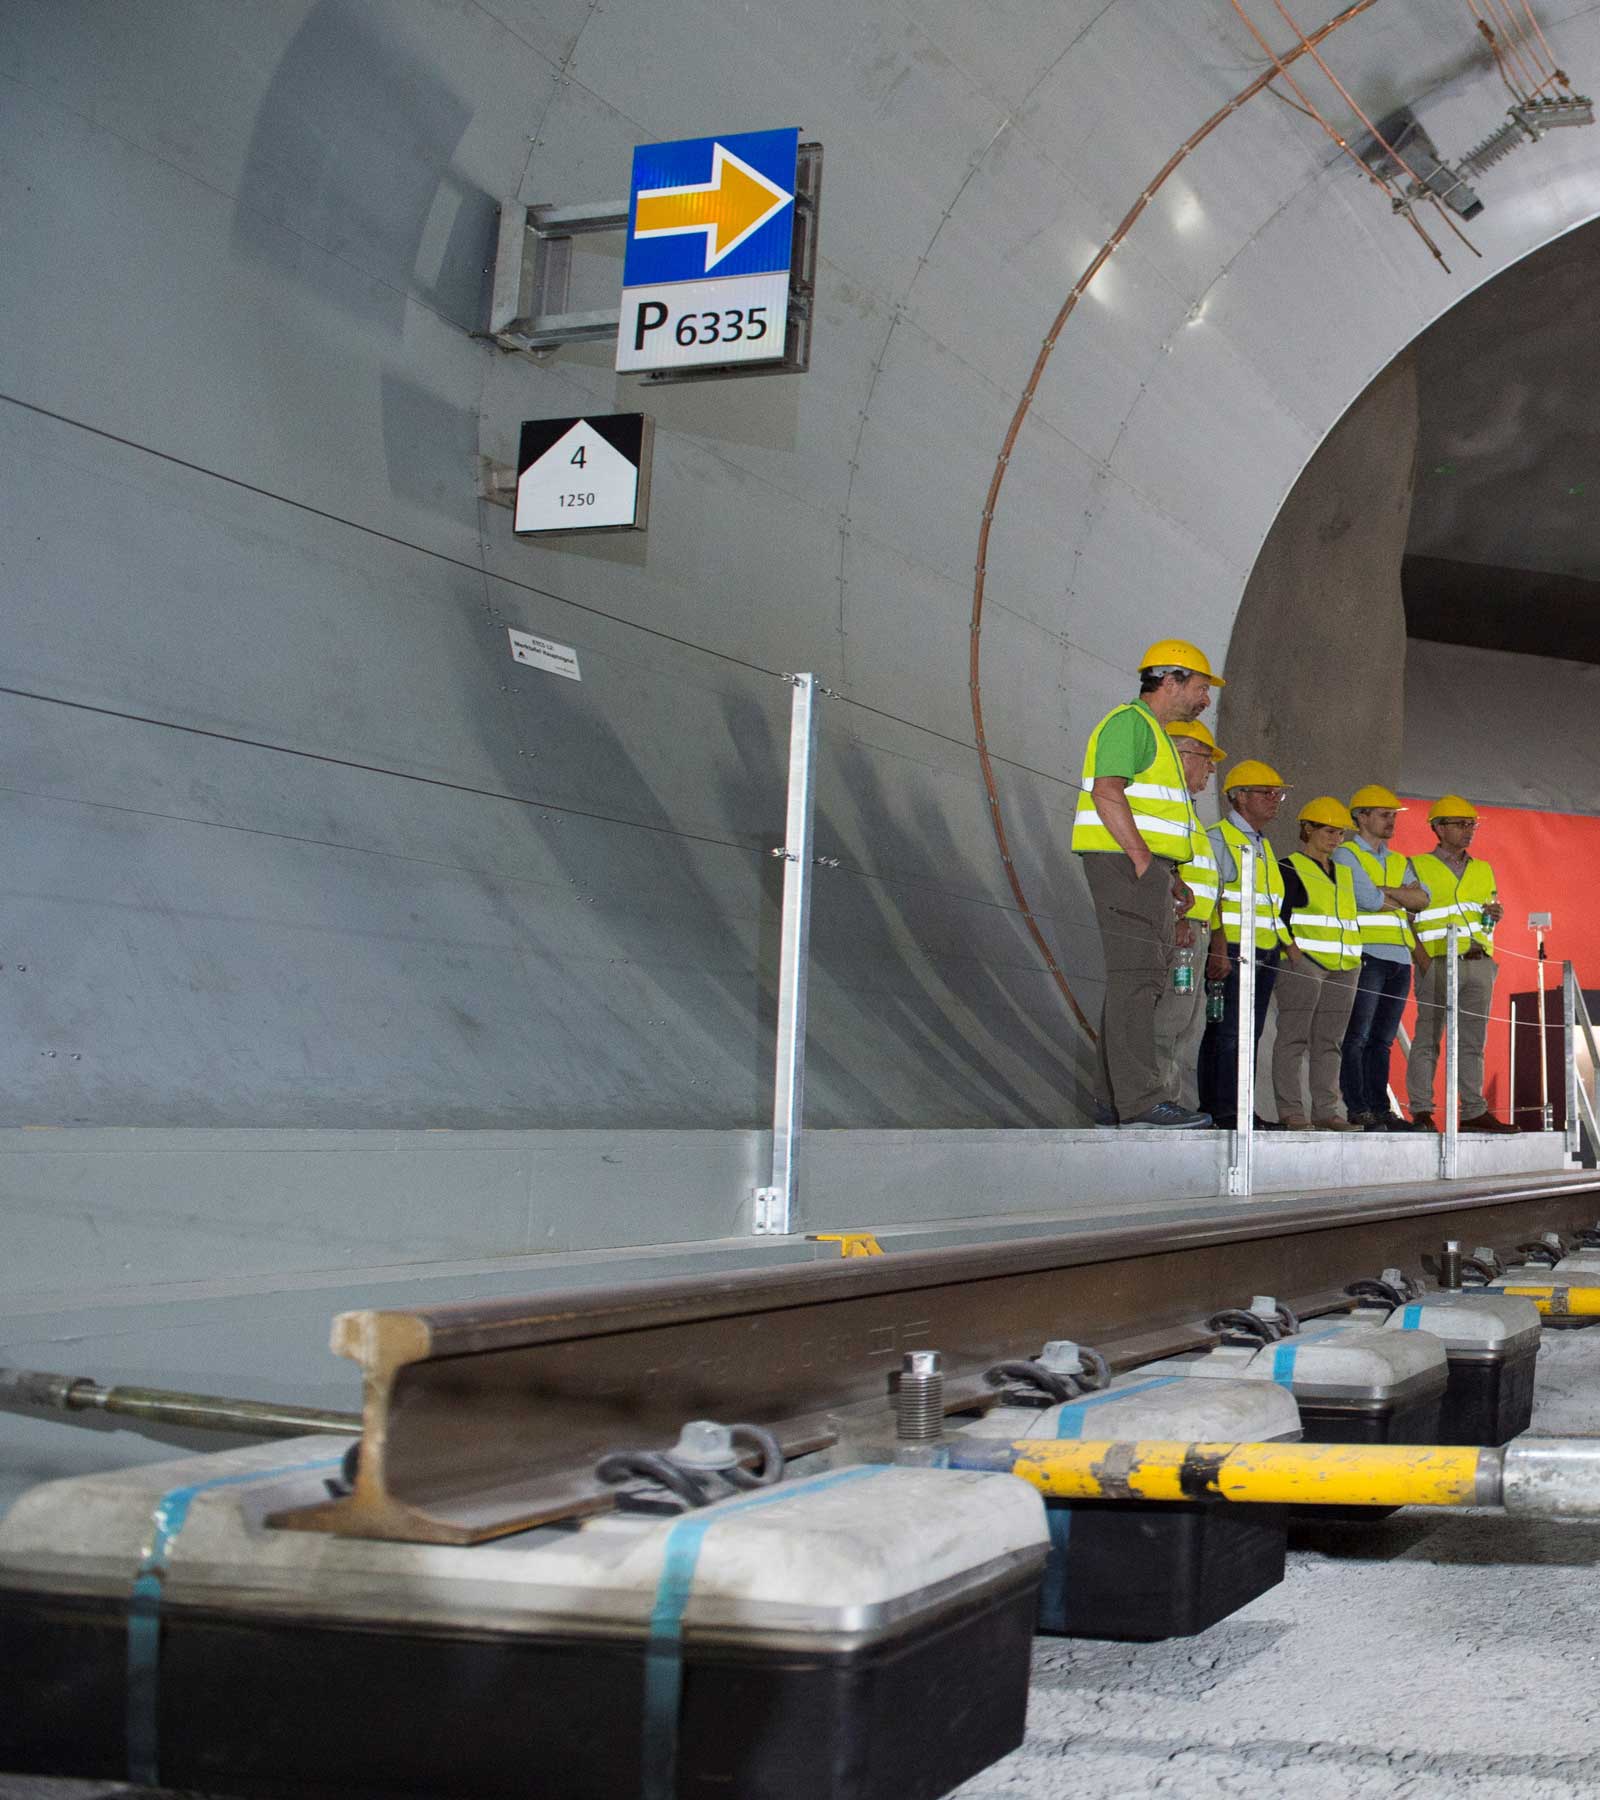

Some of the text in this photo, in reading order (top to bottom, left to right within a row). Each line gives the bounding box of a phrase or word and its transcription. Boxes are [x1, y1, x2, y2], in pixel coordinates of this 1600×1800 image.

[635, 301, 767, 350] P 6335
[570, 446, 587, 469] 4
[559, 492, 595, 507] 1250
